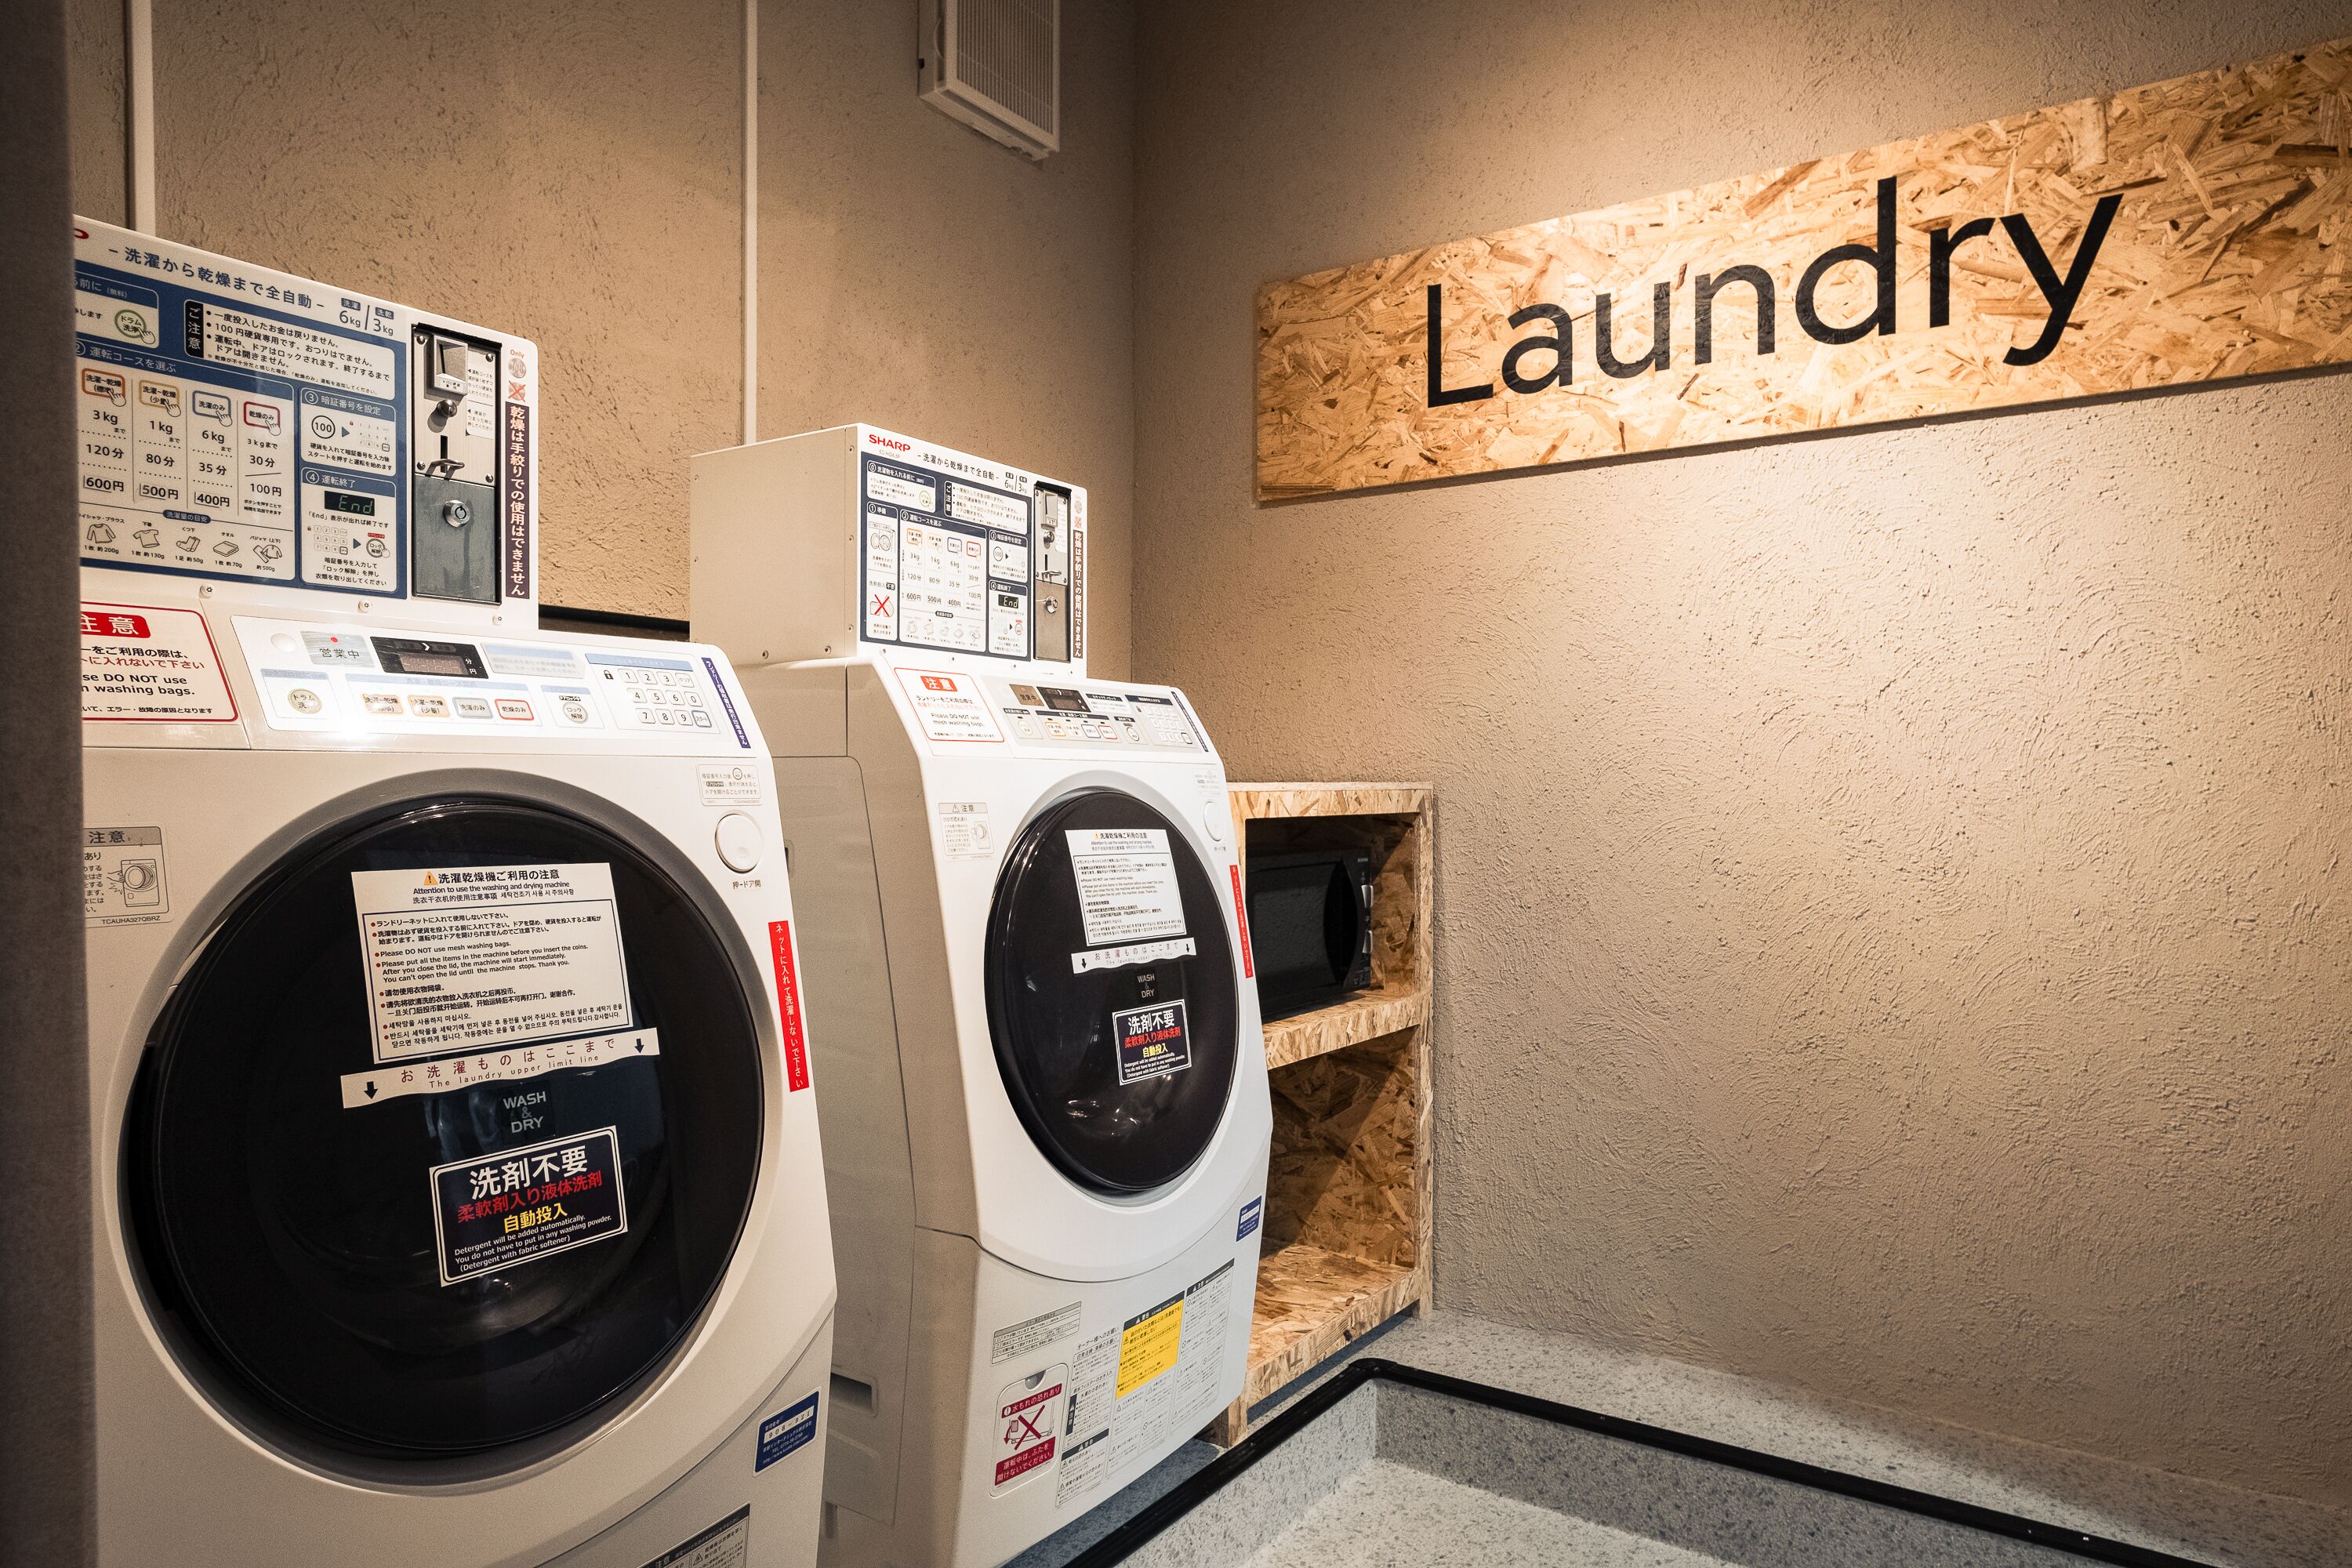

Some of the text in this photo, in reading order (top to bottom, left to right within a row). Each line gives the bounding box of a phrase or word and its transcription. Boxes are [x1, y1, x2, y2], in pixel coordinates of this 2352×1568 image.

[1427, 176, 2124, 408] Laundry
[187, 307, 201, 350] ご注意
[89, 347, 177, 373] 運転コースを選ぶ
[510, 349, 524, 358] Only
[321, 395, 381, 416] 暗証番号を設定
[314, 422, 332, 433] 100
[869, 434, 911, 452] SHARP
[86, 444, 124, 459] 120分
[146, 453, 175, 467] 80分
[249, 455, 275, 468] 30分
[198, 463, 227, 476] 35分
[85, 477, 124, 492] 600円
[321, 474, 356, 488] 運転終了
[142, 485, 179, 499] 500円
[250, 483, 282, 497] 100円
[197, 493, 230, 507] 400円
[338, 495, 373, 514] End
[510, 405, 525, 597] 乾燥は手絞りでの使用はできません
[1003, 596, 1018, 608] End
[318, 647, 360, 659] 営業中
[103, 673, 125, 682] DO
[129, 674, 158, 684] NOT
[94, 685, 195, 696] washing bags.
[89, 830, 126, 844] 注意
[438, 869, 560, 884] 洗濯乾燥機ご利用の注意
[528, 953, 566, 962] immediately.
[489, 964, 516, 973] machine
[1137, 973, 1156, 983] WASH
[1141, 989, 1155, 999] DRY
[775, 923, 804, 1089] ネットに入れて洗濯しないで下さい
[1127, 1009, 1175, 1036] 洗剤不要
[1123, 1026, 1181, 1048] 柔軟剤入り液体洗剤
[1142, 1043, 1169, 1058] 自動投入
[429, 1054, 599, 1089] The laundry upper limit line
[503, 1091, 547, 1110] WASH
[521, 1106, 532, 1119] &
[510, 1116, 544, 1134] DRY
[470, 1145, 588, 1201] 洗剤不要
[457, 1170, 603, 1224] 柔軟剤入り液体洗剤
[503, 1202, 568, 1235] 自動投入
[455, 1214, 586, 1256] Detergent will be added automatically.
[455, 1215, 612, 1265] You do not have put any washing powder.
[459, 1234, 571, 1272] (Detergent with fabric softener)
[1011, 1385, 1060, 1413] 水もれの恐れあり
[1003, 1442, 1050, 1471] 運転中は、ふたを
[996, 1453, 1053, 1483] 開けないでください。
